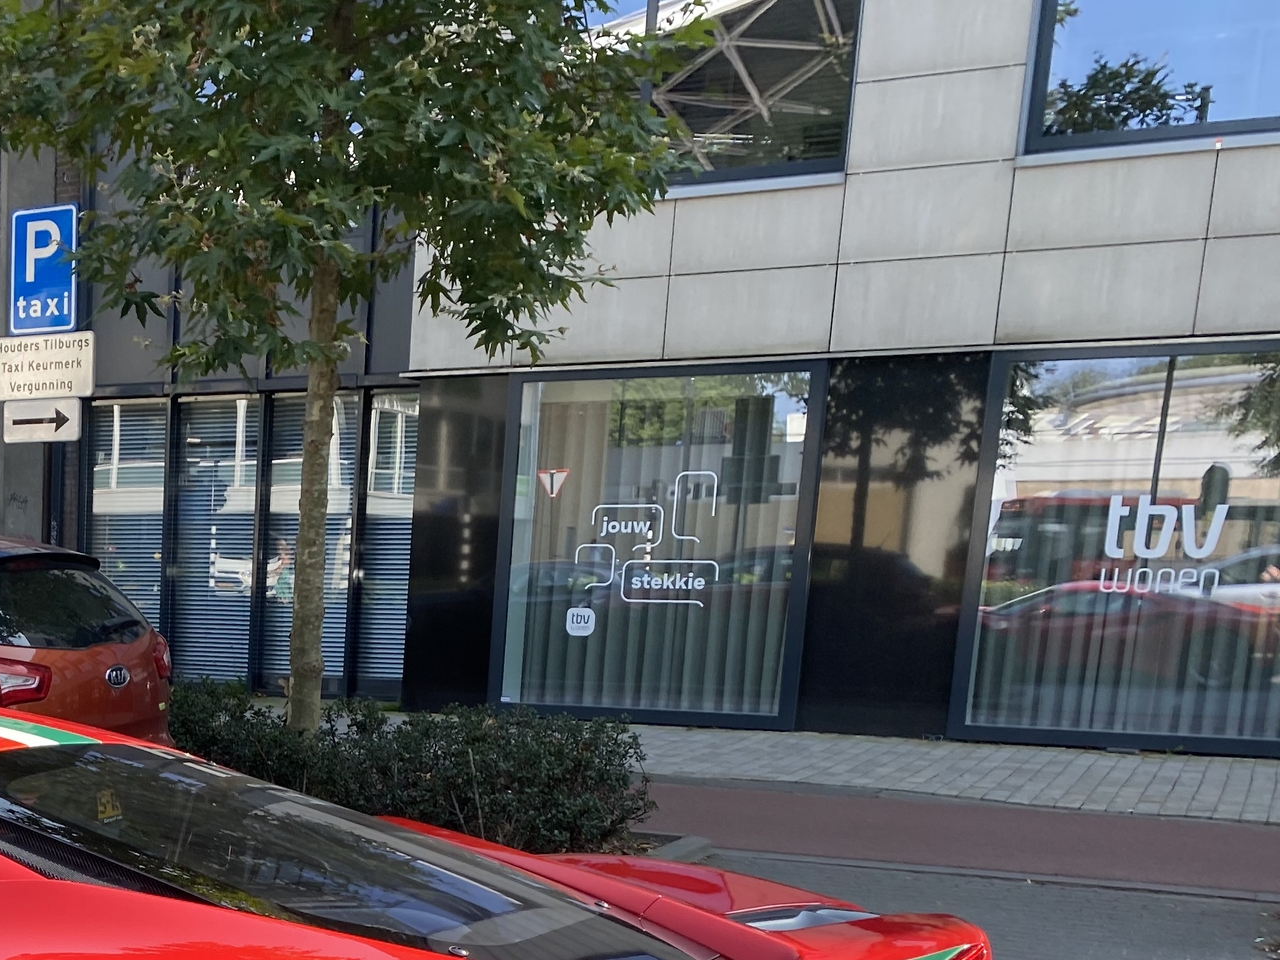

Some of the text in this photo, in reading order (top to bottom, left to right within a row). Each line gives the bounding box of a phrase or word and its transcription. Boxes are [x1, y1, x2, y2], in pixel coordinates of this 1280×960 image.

[25, 219, 61, 283] P
[17, 292, 69, 319] taxi
[43, 338, 90, 351] Tilburgs
[1, 358, 82, 374] Taxi Keurmerk
[9, 379, 73, 395] Vergunning
[600, 516, 651, 537] jouw
[1104, 494, 1230, 559] tbv
[631, 573, 706, 590] stekkie
[1099, 567, 1220, 597] wonen
[571, 612, 591, 624] tbv
